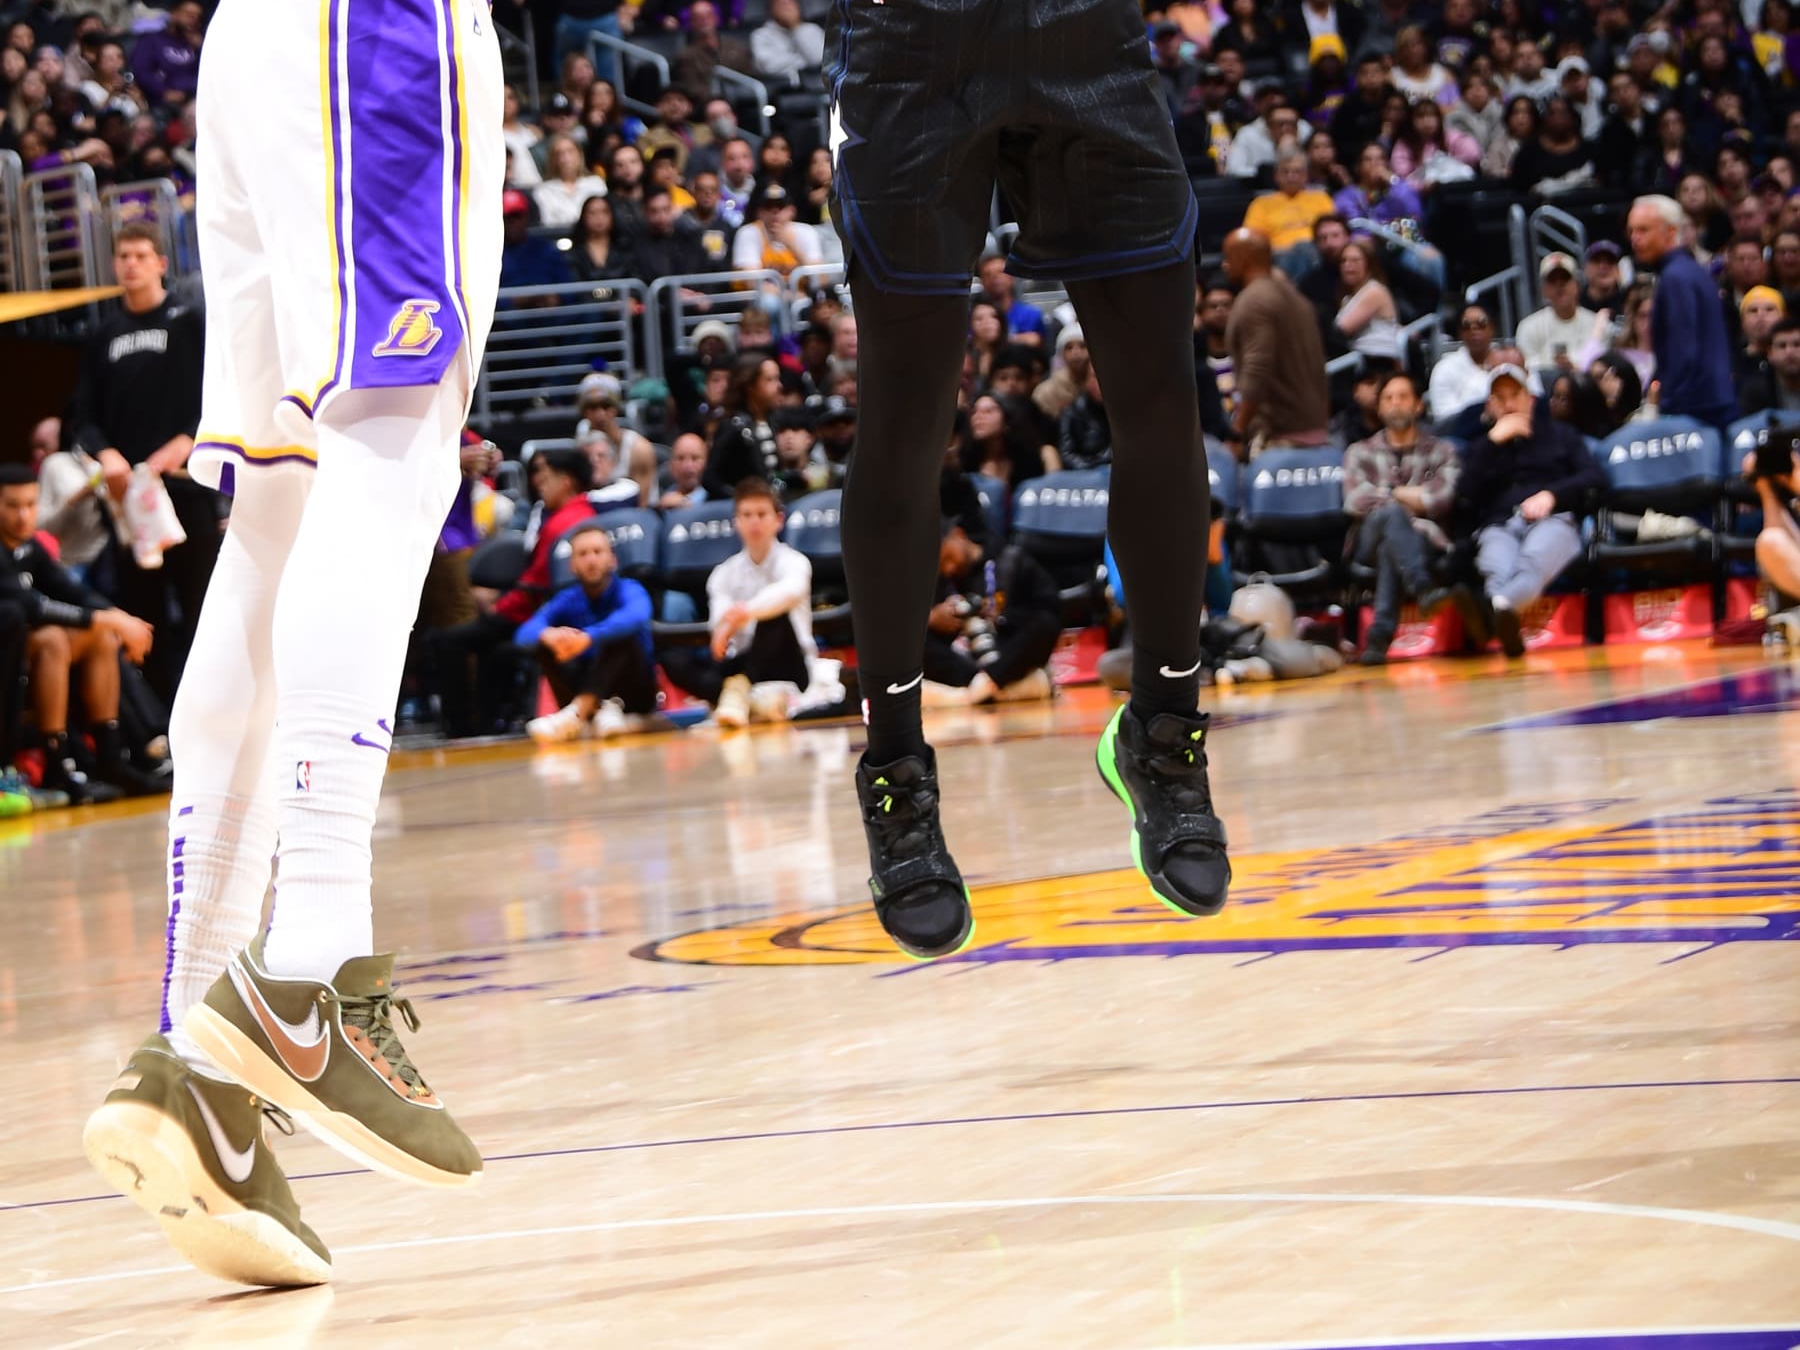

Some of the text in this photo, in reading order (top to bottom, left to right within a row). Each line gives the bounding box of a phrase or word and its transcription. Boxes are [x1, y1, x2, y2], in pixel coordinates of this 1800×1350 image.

[1630, 432, 1704, 461] DELTA
[1275, 465, 1344, 488] DELTA
[1039, 487, 1110, 508] DELTA
[690, 518, 734, 540] DEL
